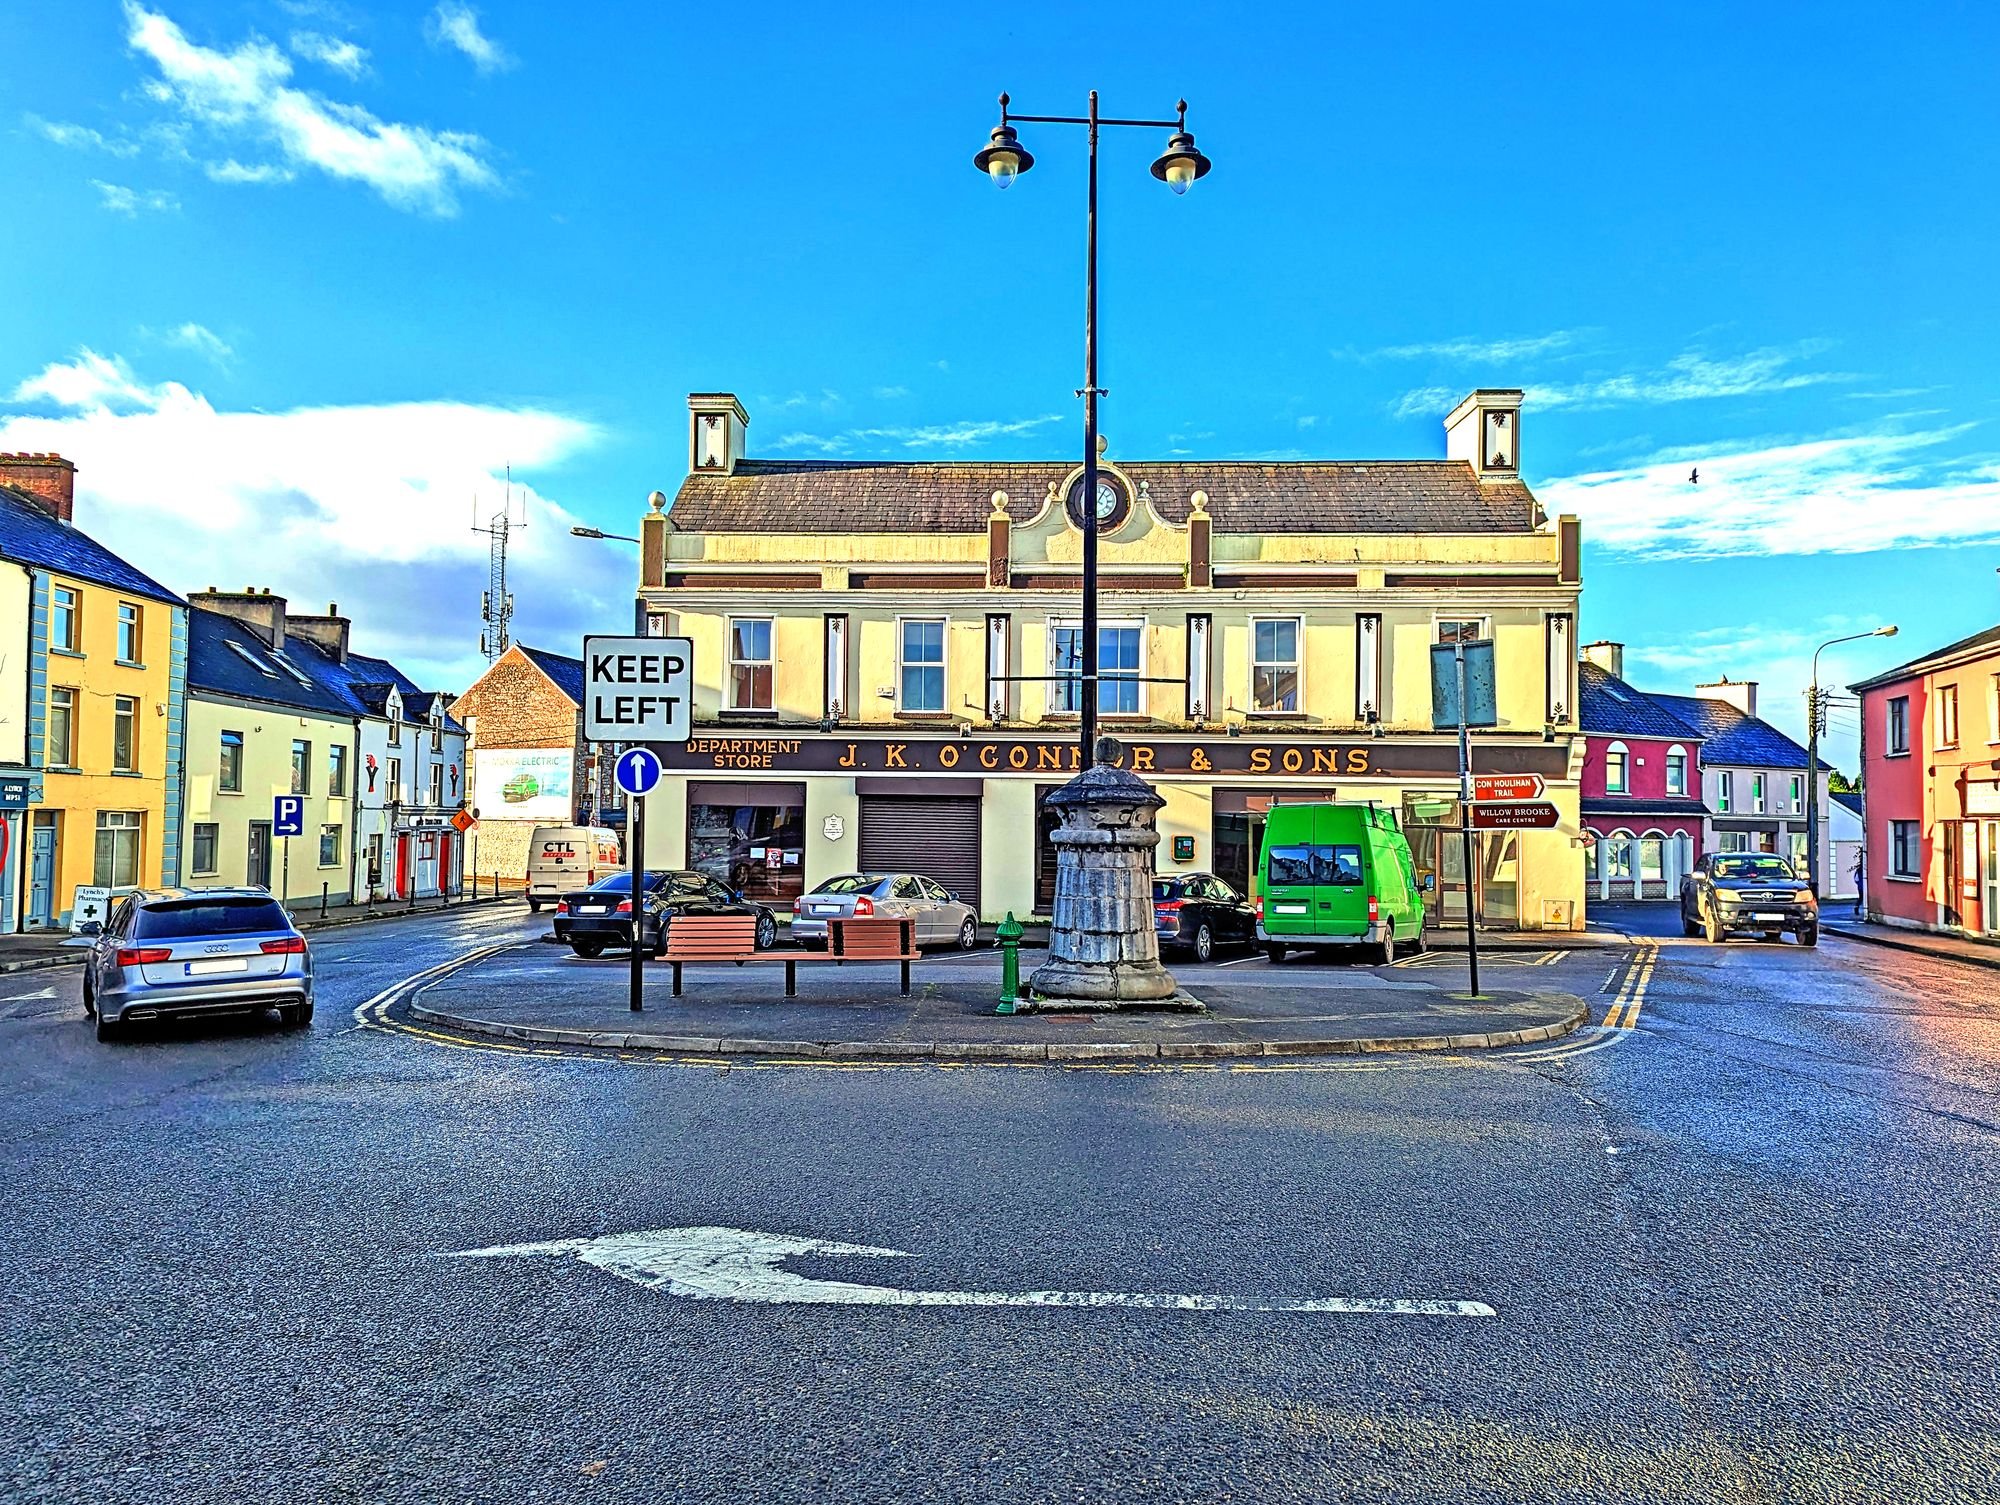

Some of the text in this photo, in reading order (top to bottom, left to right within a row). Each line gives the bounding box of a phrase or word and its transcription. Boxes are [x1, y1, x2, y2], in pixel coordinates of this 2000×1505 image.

[592, 654, 685, 684] KEEP
[595, 695, 680, 725] LEFT
[686, 739, 802, 754] DEPARTMENT
[521, 756, 560, 766] ELECTRIC
[713, 754, 773, 768] STORE
[838, 744, 868, 767] J.
[884, 744, 921, 768] K.
[1190, 747, 1213, 771] &
[1249, 747, 1383, 773] SONS.
[1476, 779, 1531, 788] CON HOULIHAN
[1493, 789, 1515, 797] TRAIL
[281, 799, 297, 821] P
[1514, 808, 1551, 816] BROOKE
[544, 842, 574, 852] CTL
[82, 888, 104, 896] Lynch's
[77, 895, 106, 904] Pharmacy
